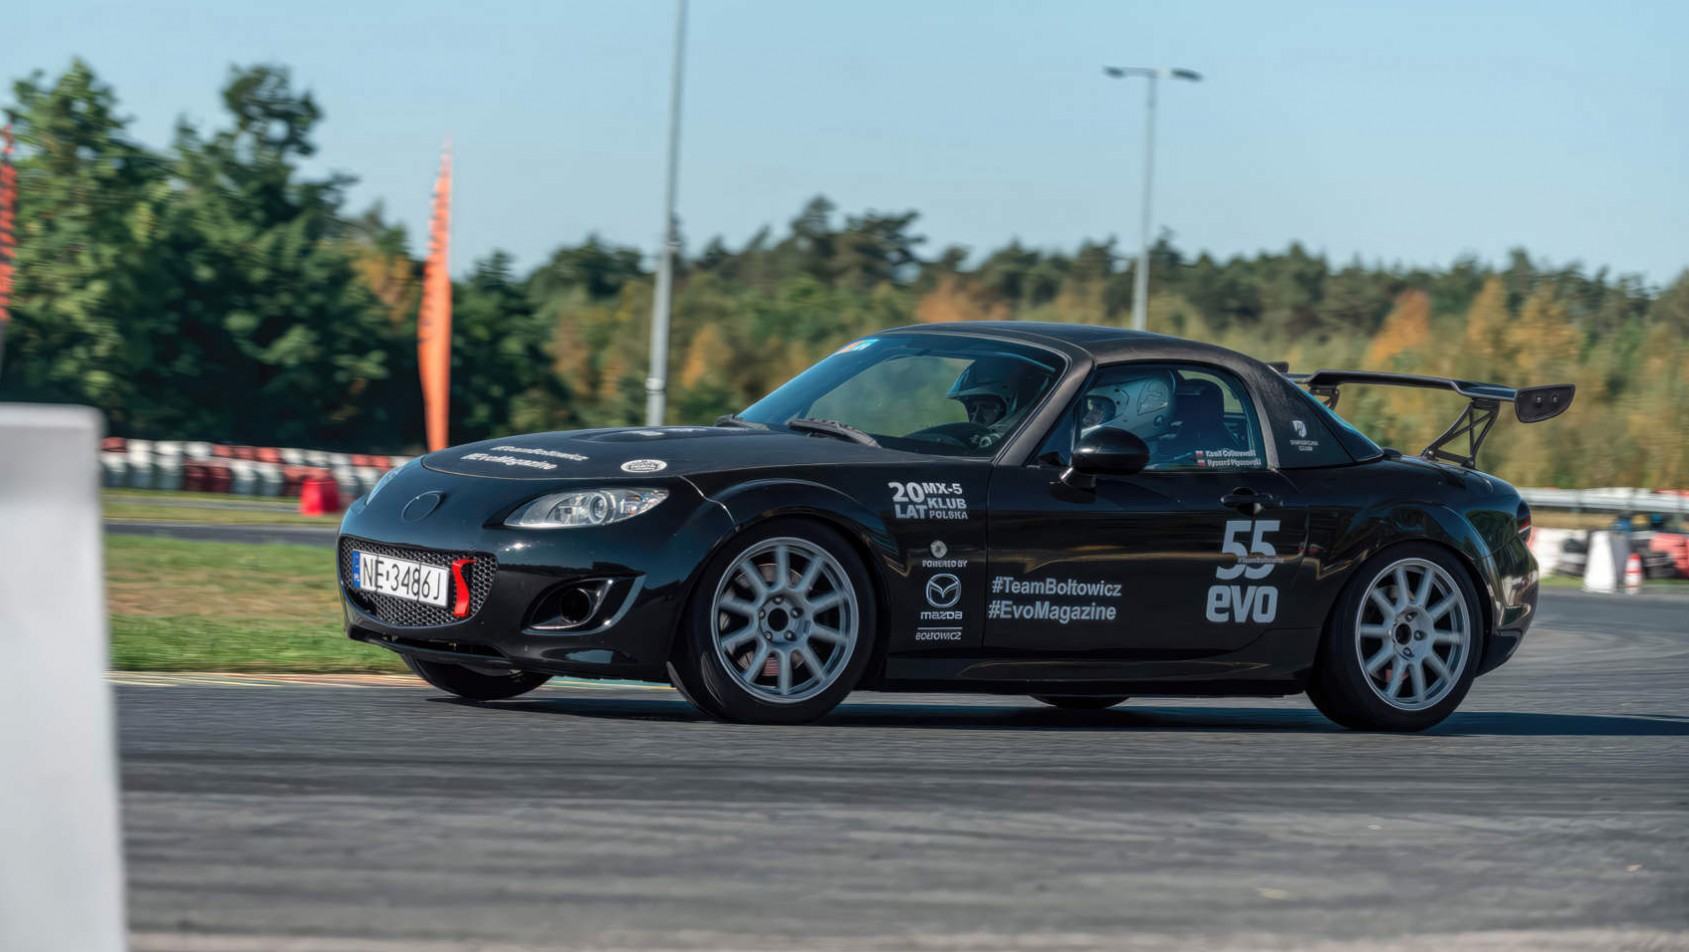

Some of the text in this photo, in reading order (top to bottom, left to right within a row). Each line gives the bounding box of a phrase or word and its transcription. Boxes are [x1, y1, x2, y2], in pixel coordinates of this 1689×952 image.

[888, 482, 963, 503] 20 MX-5
[895, 497, 967, 519] LAT KLUB
[929, 510, 969, 520] POLSKA
[1216, 520, 1281, 580] 55
[363, 557, 442, 600] NE 3486J
[988, 600, 1117, 624] #EvoMagazine
[1205, 585, 1279, 623] evo
